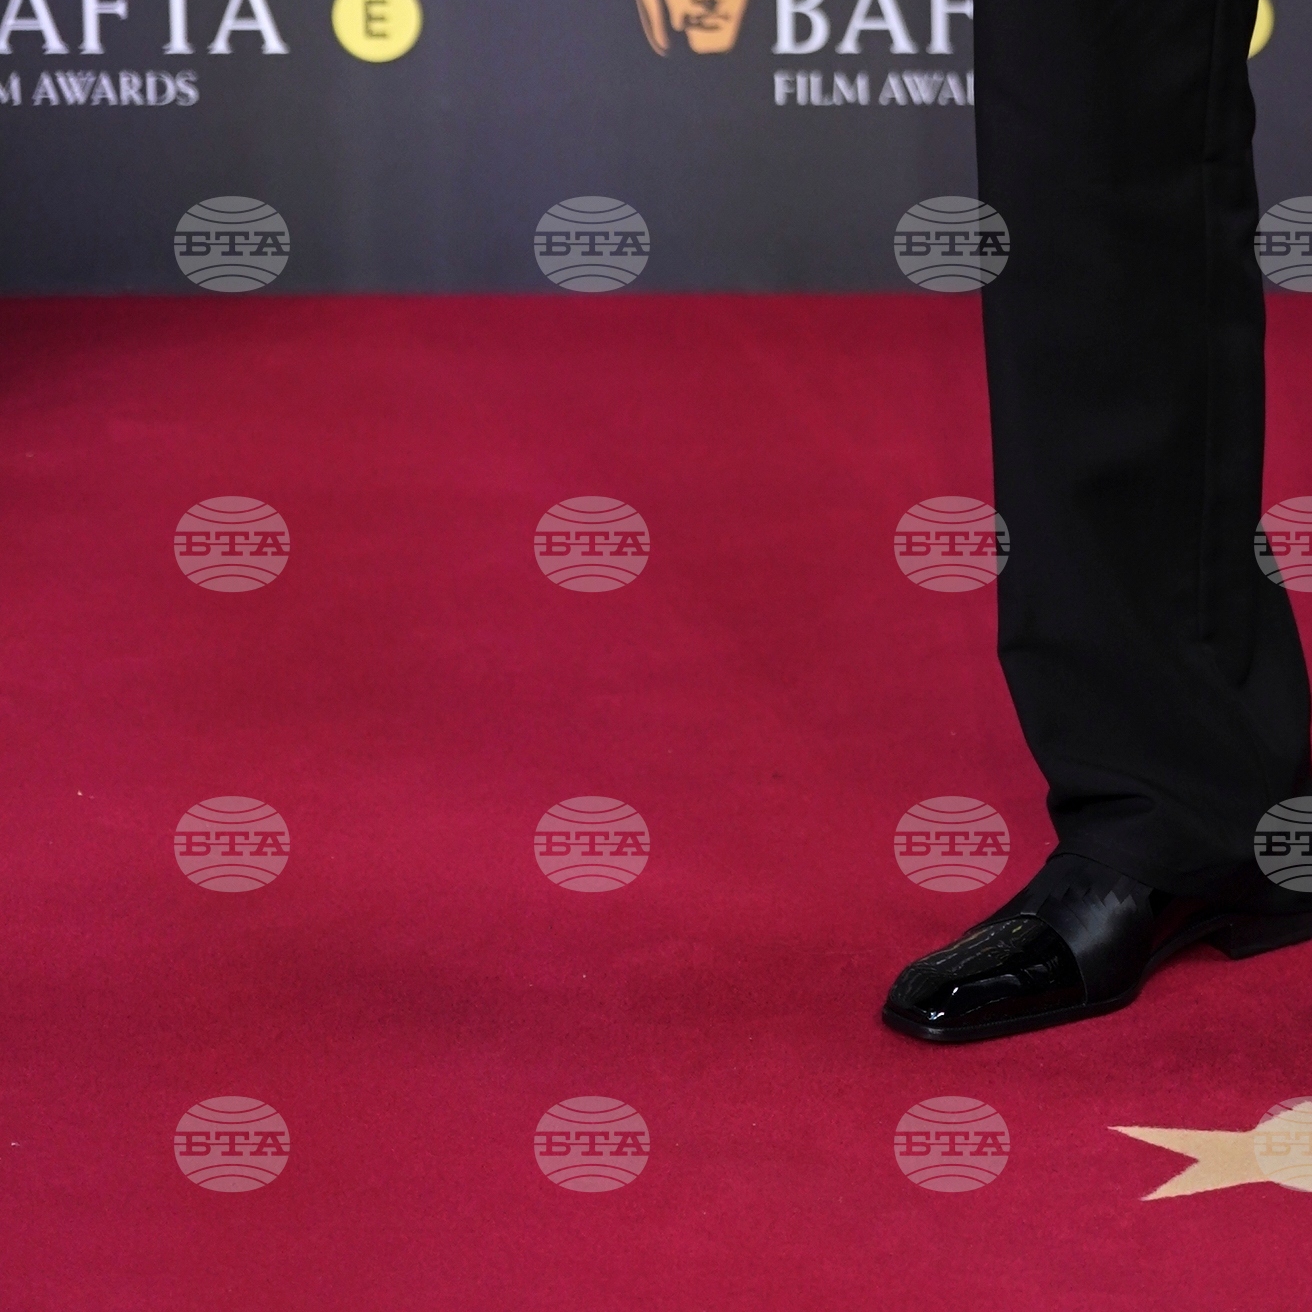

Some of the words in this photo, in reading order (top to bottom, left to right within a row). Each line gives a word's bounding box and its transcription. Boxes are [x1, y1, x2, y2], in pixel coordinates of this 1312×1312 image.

[33, 71, 199, 105] AWARDS
[774, 71, 869, 105] FILM
[878, 70, 974, 106] AWA
